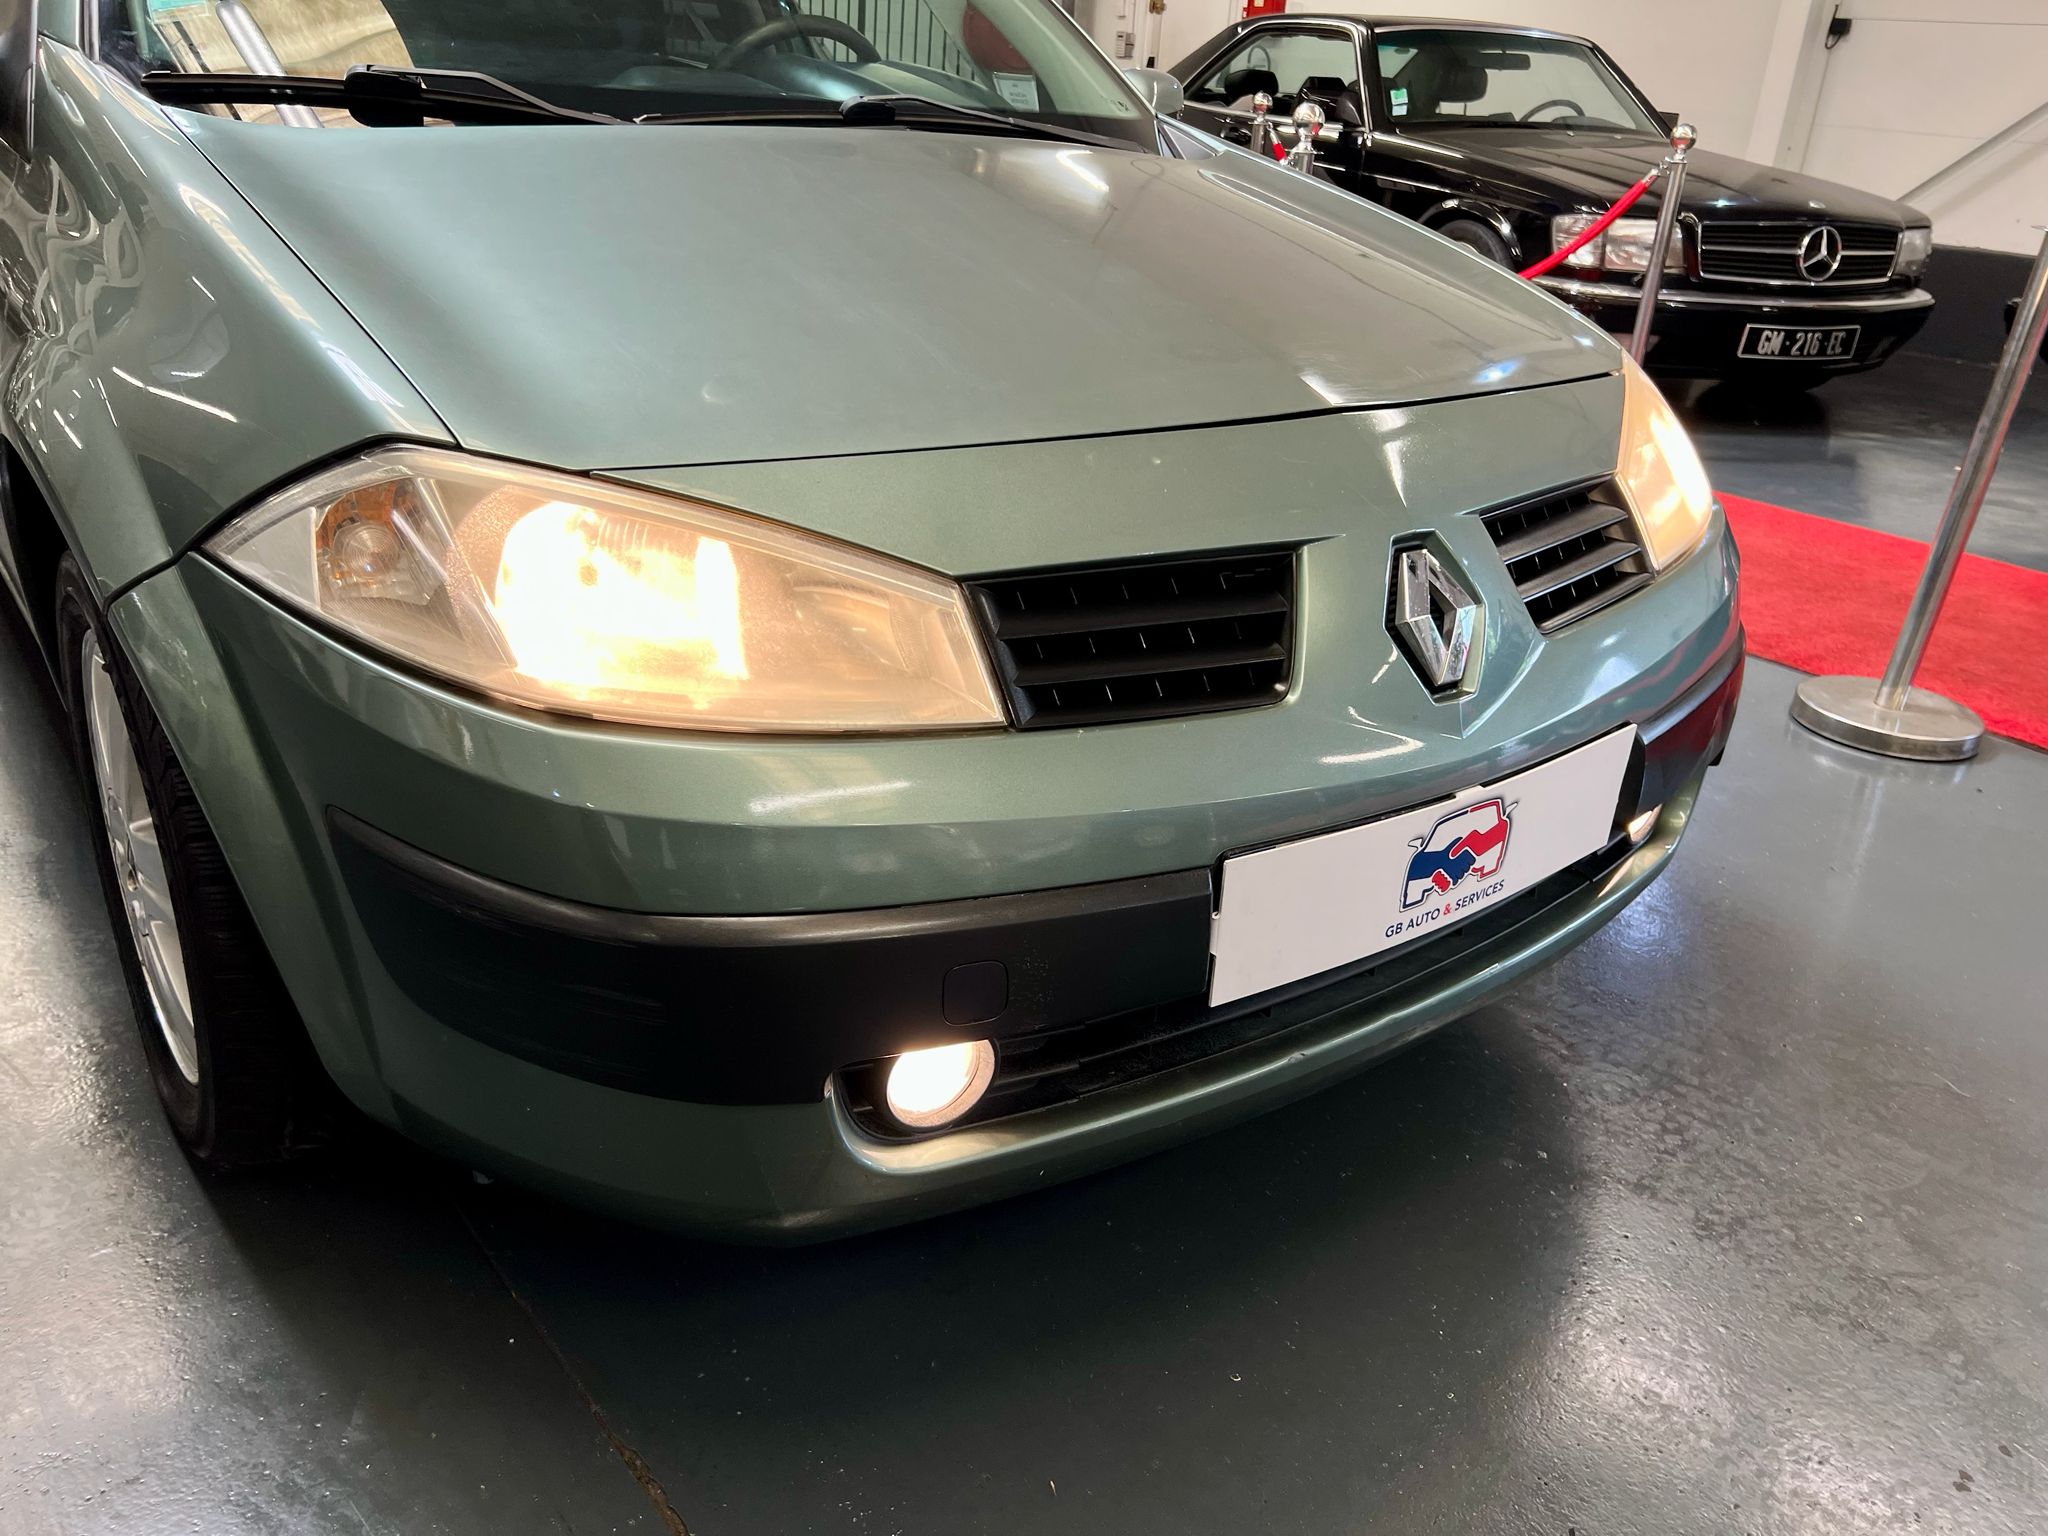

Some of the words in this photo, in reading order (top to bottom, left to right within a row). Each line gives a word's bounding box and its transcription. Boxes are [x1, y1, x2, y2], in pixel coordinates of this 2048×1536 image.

[1385, 922, 1403, 938] GB
[1405, 908, 1441, 931] AUTO
[1443, 903, 1452, 916] &
[1454, 879, 1505, 912] SERVICES
